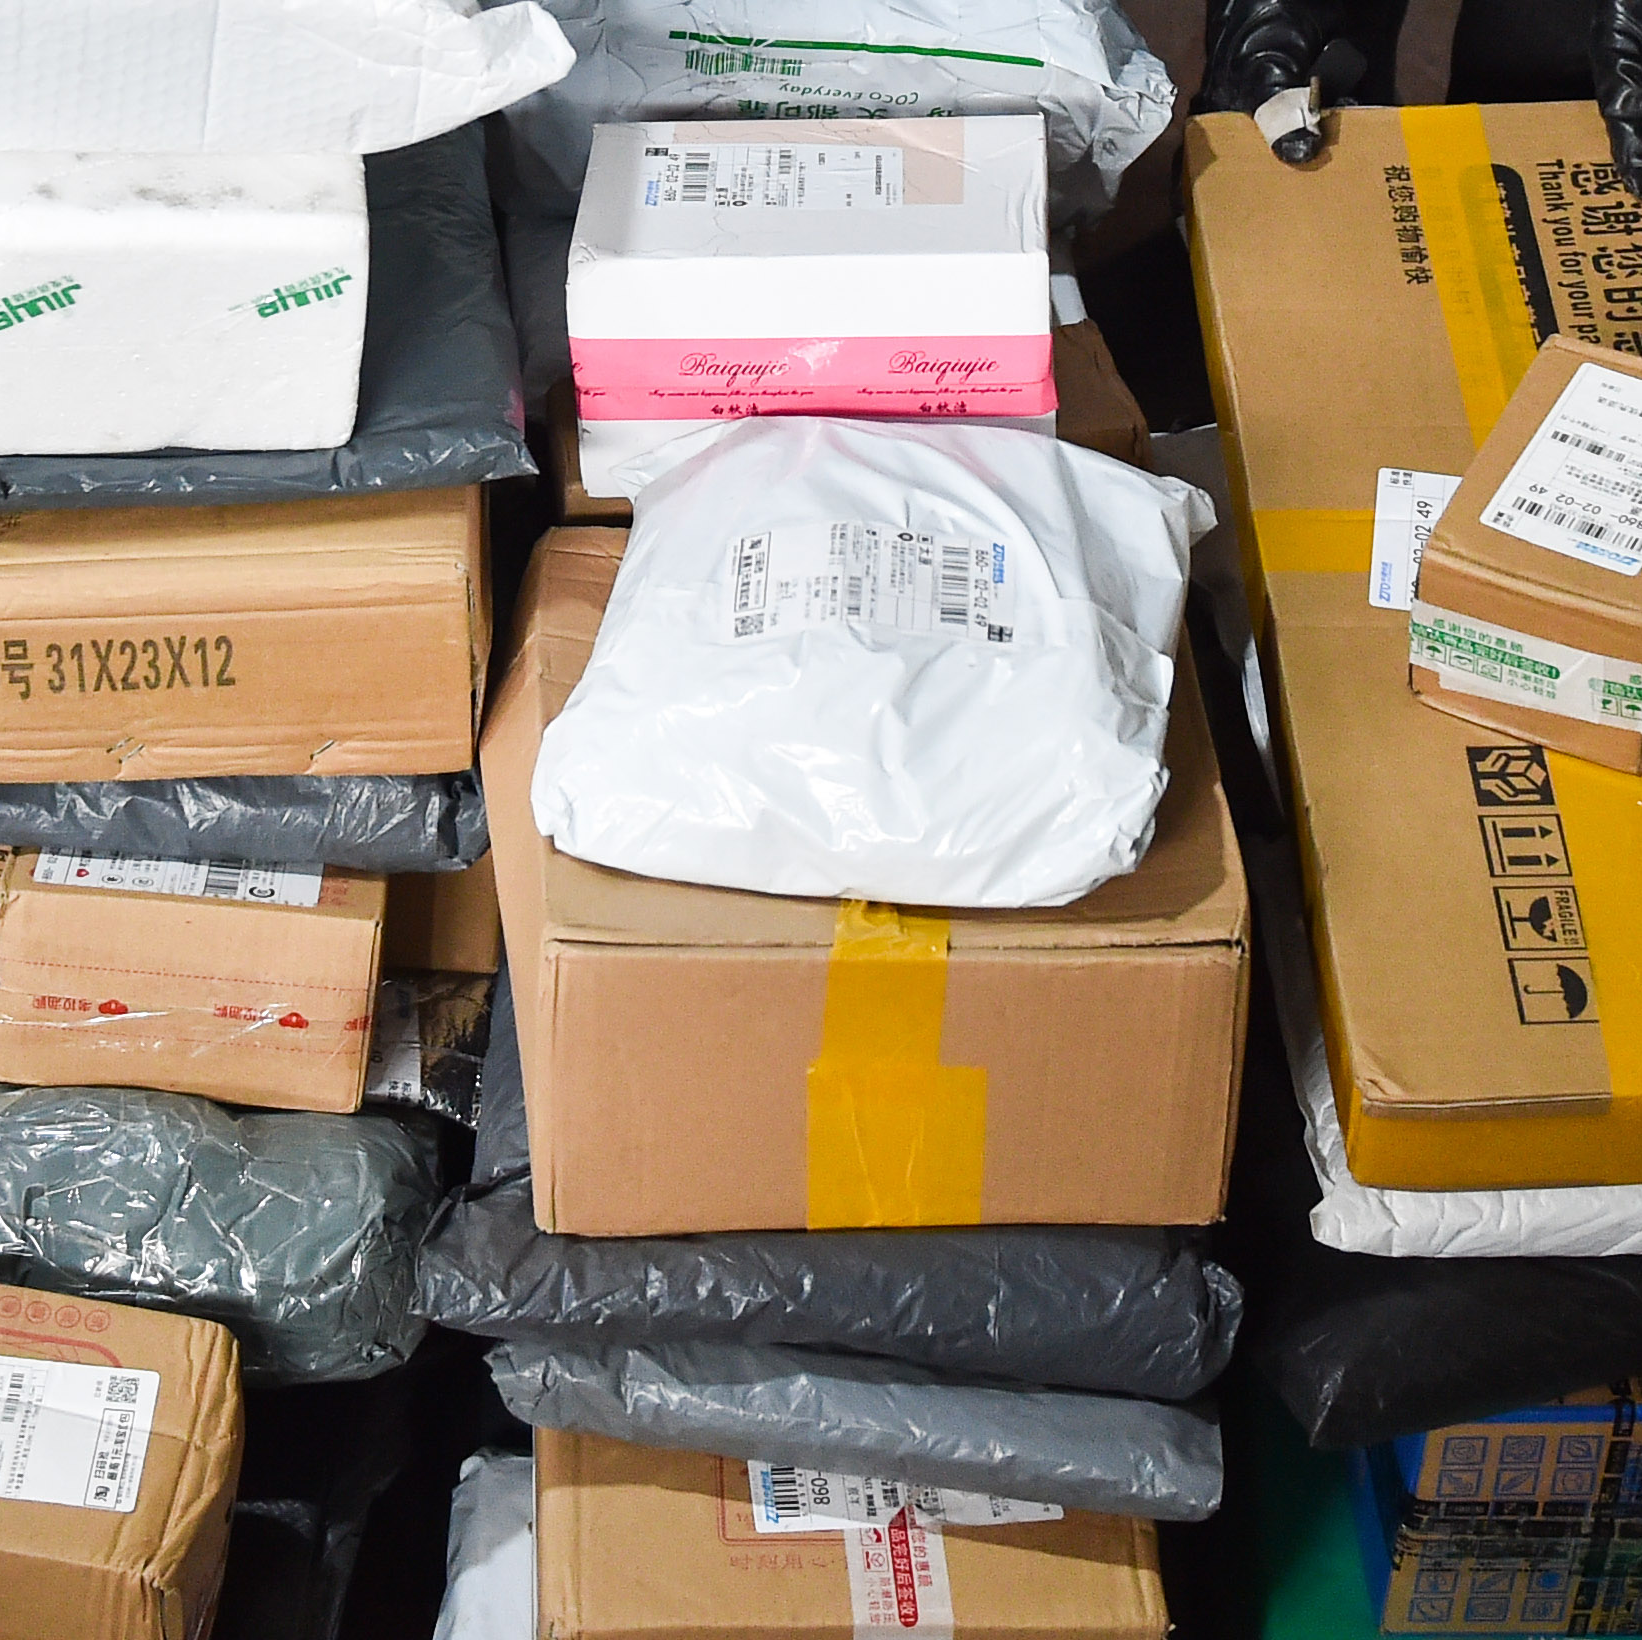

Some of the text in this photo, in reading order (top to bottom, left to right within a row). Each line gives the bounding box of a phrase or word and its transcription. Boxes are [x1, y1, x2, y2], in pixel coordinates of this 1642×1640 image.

[779, 83, 863, 101] Everyday
[664, 153, 680, 201] 860- 02-02 49
[1536, 159, 1573, 213] Thank
[1384, 165, 1433, 284] 祝您购物愉快
[1542, 218, 1577, 247] you
[1558, 251, 1586, 276] for
[1558, 280, 1594, 318] your
[679, 352, 792, 387] Baiqiujie
[888, 350, 1000, 386] Baiqiujie
[1529, 483, 1548, 496] 49
[1555, 494, 1602, 516] 02-02
[1417, 500, 1433, 518] 49
[974, 549, 988, 628] 860- 02-02 49
[46, 635, 236, 694] 31X23X12
[1554, 889, 1578, 938] FRAGILE
[811, 1471, 831, 1505] 860-
